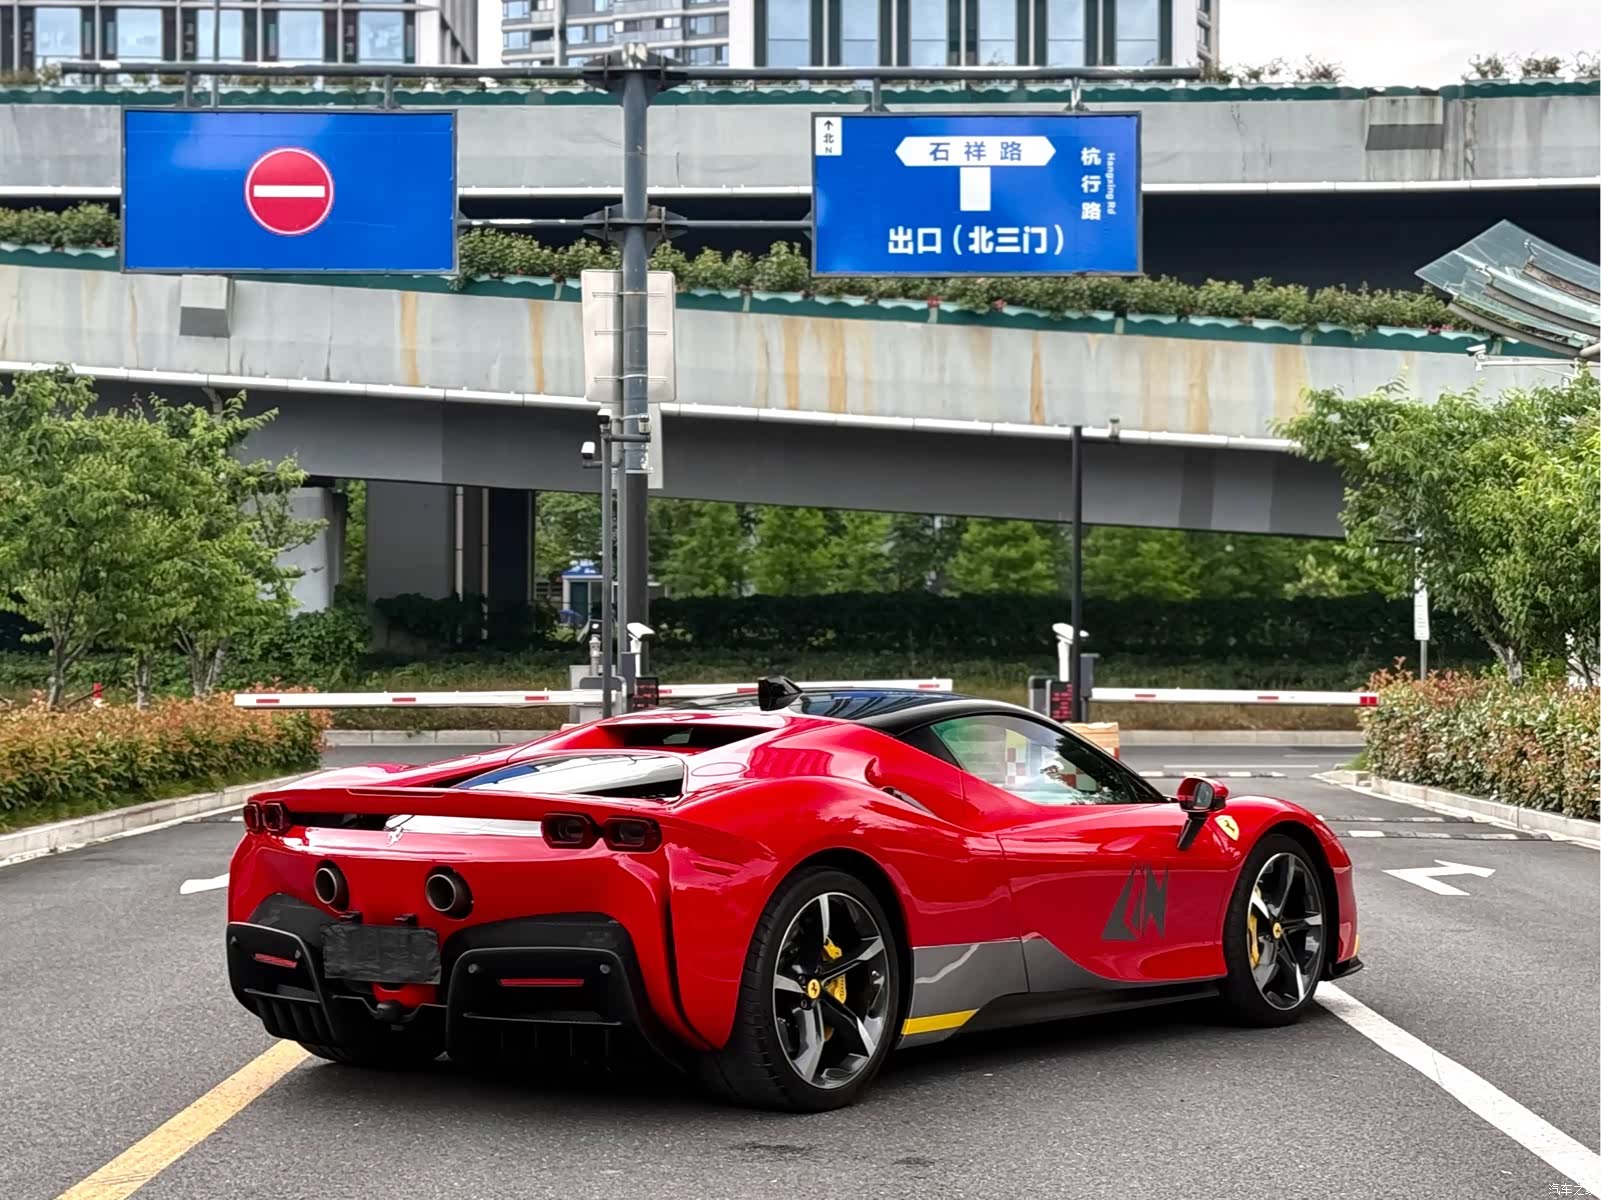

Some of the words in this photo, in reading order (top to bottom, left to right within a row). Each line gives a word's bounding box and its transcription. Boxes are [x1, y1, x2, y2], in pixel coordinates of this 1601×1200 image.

[823, 132, 834, 144] 北
[825, 146, 832, 154] N
[929, 141, 1022, 162] 石祥路
[1081, 147, 1101, 220] 杭行路
[1105, 152, 1116, 200] Hangxing
[1106, 201, 1117, 215] Rd
[888, 224, 1064, 256] 出口（北三门）
